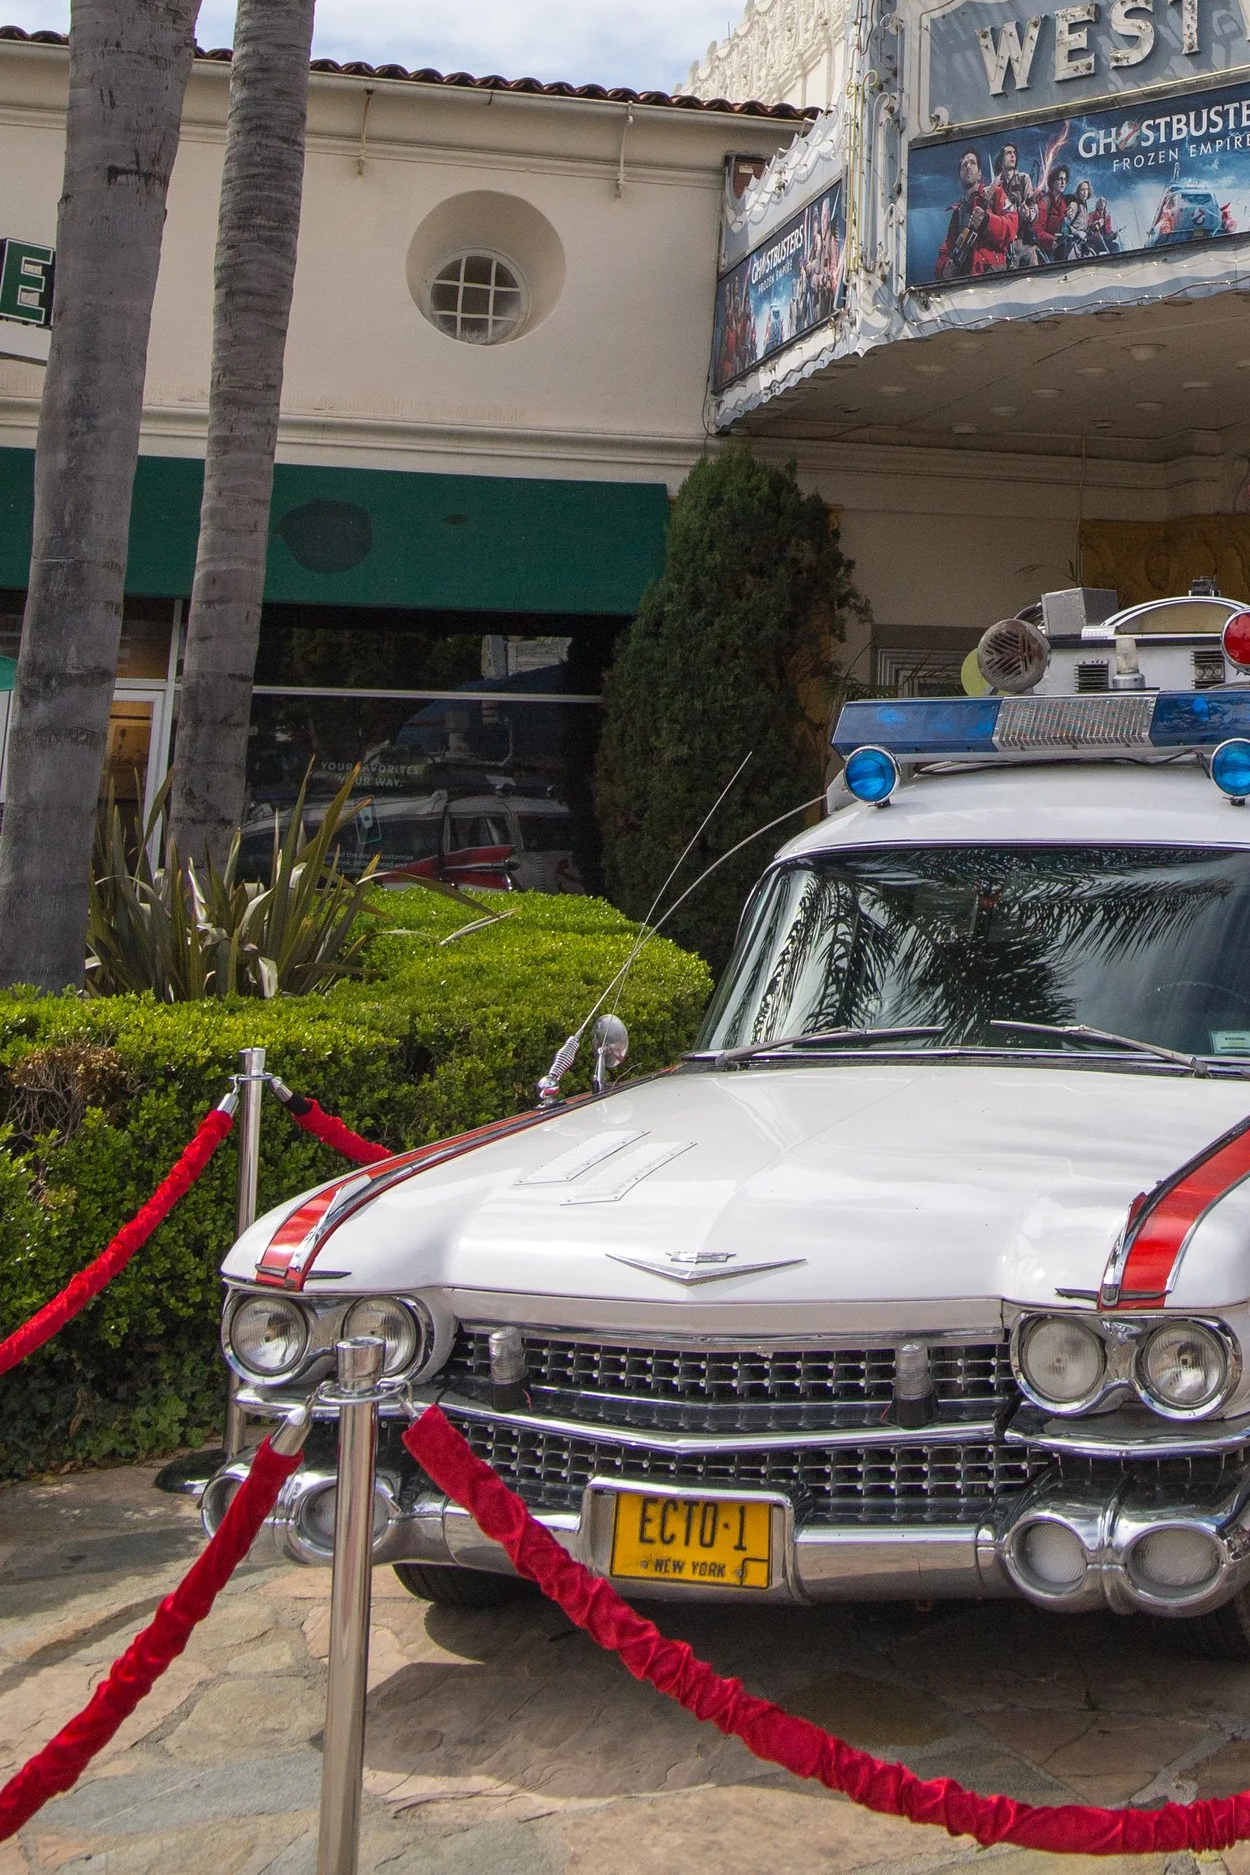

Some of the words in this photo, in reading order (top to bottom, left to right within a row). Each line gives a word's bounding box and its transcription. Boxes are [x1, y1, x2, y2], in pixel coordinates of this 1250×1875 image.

[1112, 147, 1179, 173] FROZEN
[362, 764, 423, 775] AVORITES.
[654, 1557, 685, 1574] NEW
[691, 1561, 727, 1578] YORK
